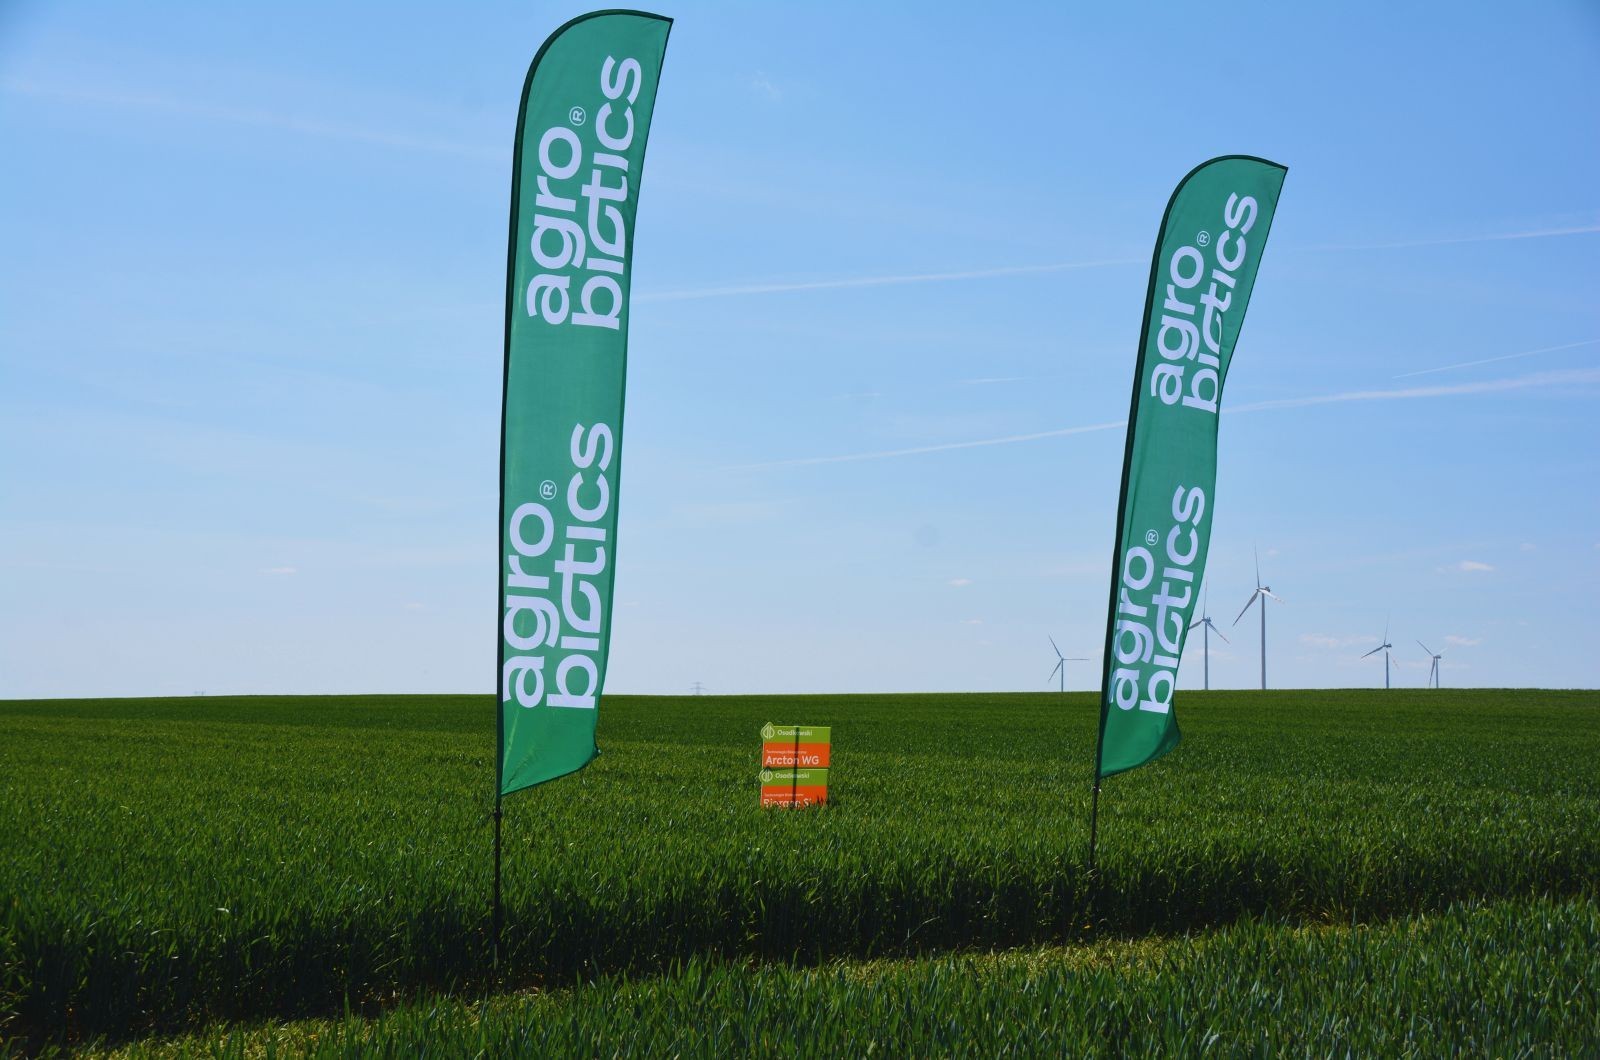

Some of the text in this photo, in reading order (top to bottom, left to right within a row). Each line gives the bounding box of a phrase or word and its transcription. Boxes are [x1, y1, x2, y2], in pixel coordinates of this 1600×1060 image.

[570, 55, 642, 330] biotics
[546, 422, 614, 710] biotics
[1139, 484, 1206, 714] biotics
[765, 755, 820, 765] Arcton WG
